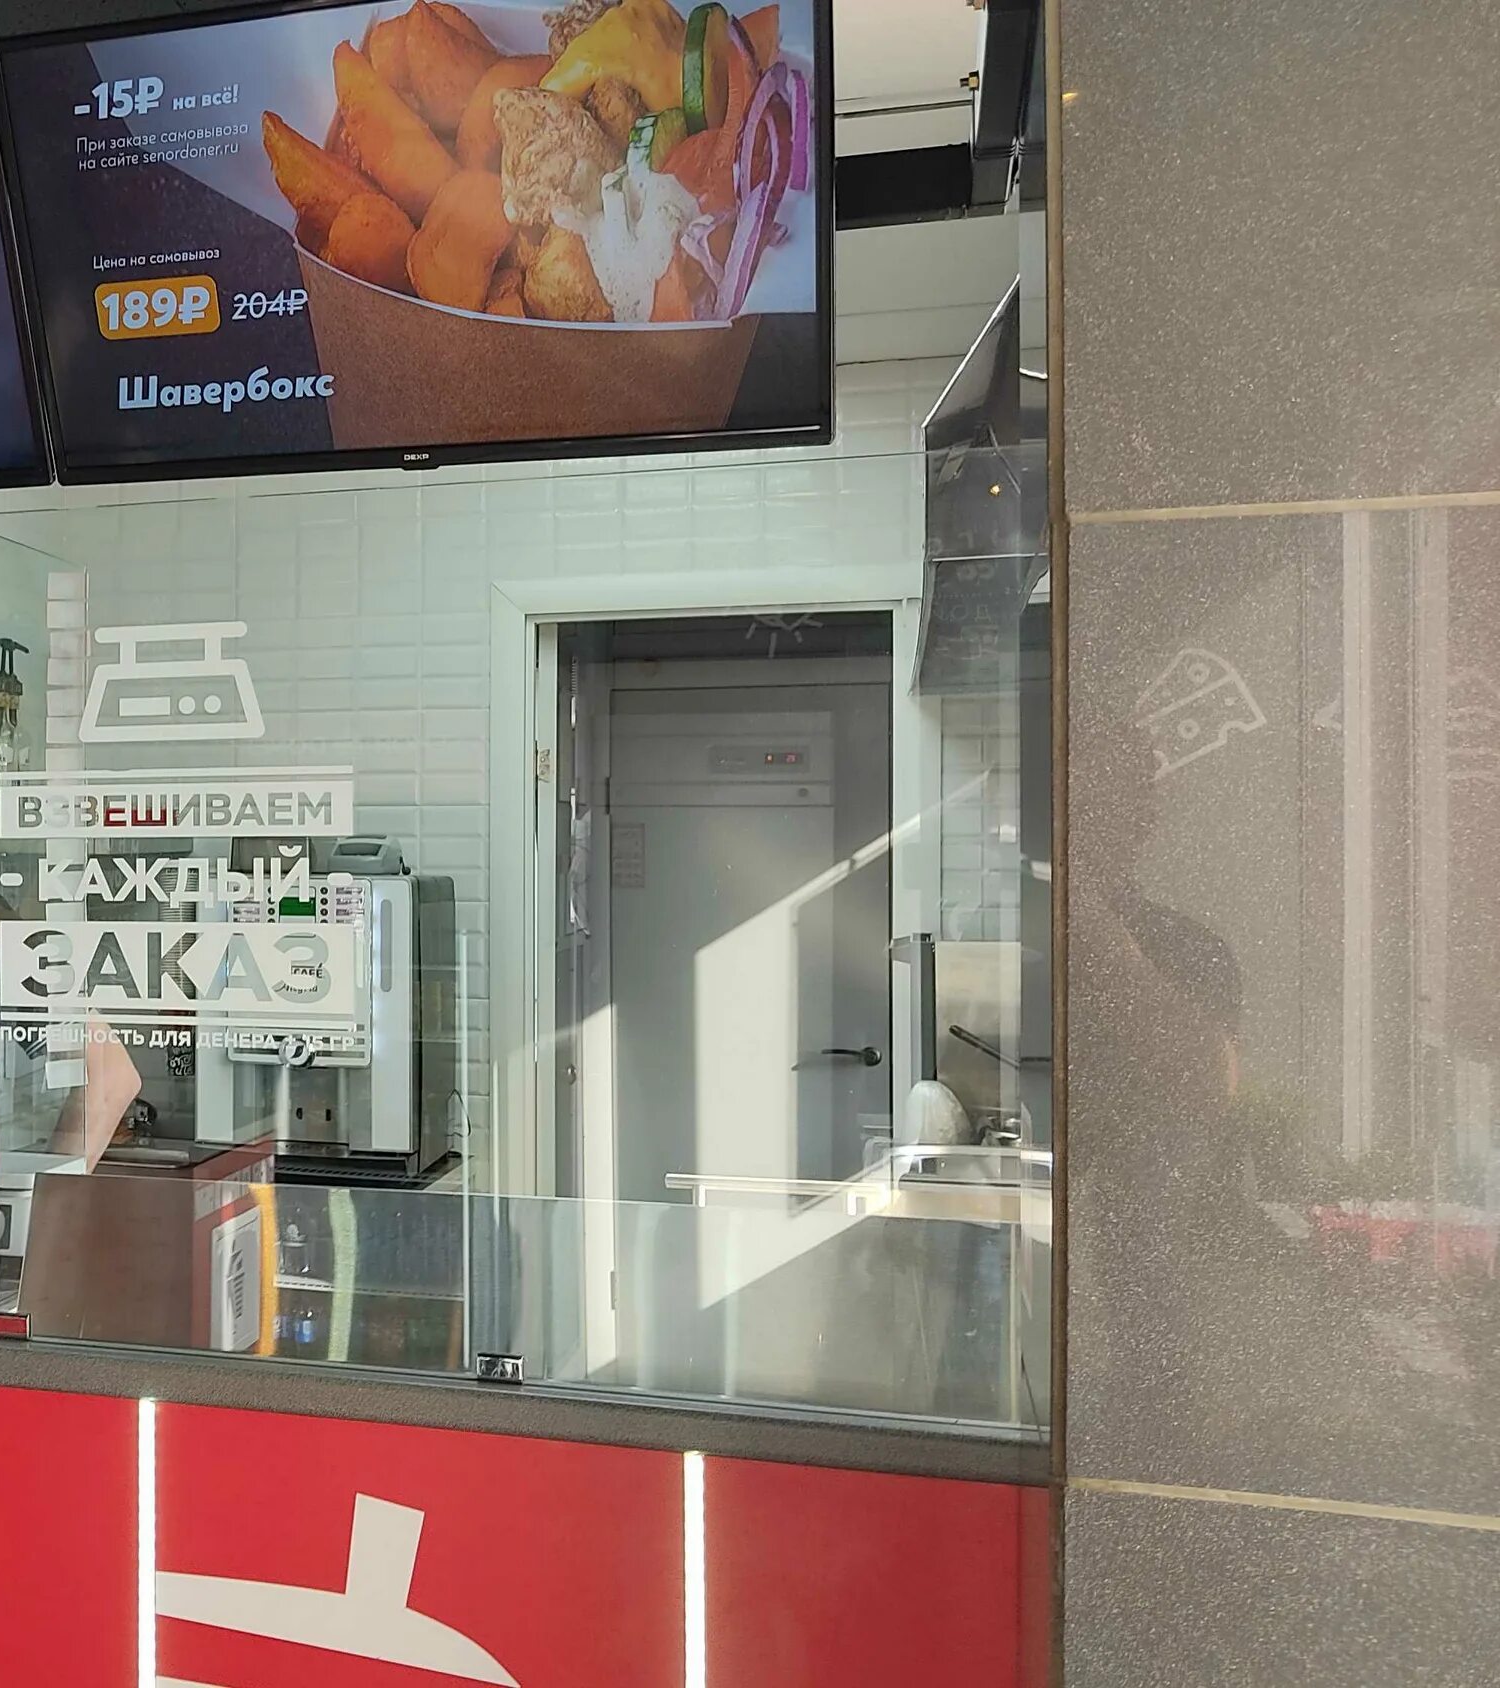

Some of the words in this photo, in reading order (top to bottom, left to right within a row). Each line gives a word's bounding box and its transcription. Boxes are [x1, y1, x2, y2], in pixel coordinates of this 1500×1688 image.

[74, 76, 164, 120] -15₽
[173, 96, 196, 110] на
[201, 84, 239, 107] всё!
[77, 136, 106, 156] При
[109, 134, 157, 149] заказе
[160, 124, 248, 143] самовывоза
[79, 159, 96, 171] на
[100, 152, 139, 168] сайте
[143, 143, 239, 164] senordoner.ru
[93, 255, 126, 272] Цена
[130, 256, 146, 267] на
[149, 248, 220, 264] самовывоз
[101, 286, 210, 331] 189₽
[232, 288, 309, 320] 204₽
[118, 366, 335, 412] Шавербокс
[403, 453, 430, 461] DEXP
[18, 791, 332, 828] ВЗВЕШИВАЕМ
[38, 845, 311, 909] КАЖДЫЙ
[21, 930, 331, 1003] ЗАКАЗ
[0, 1025, 145, 1046] ПОГРЕШНОСТЬ
[149, 1028, 192, 1048] ДЛЯ
